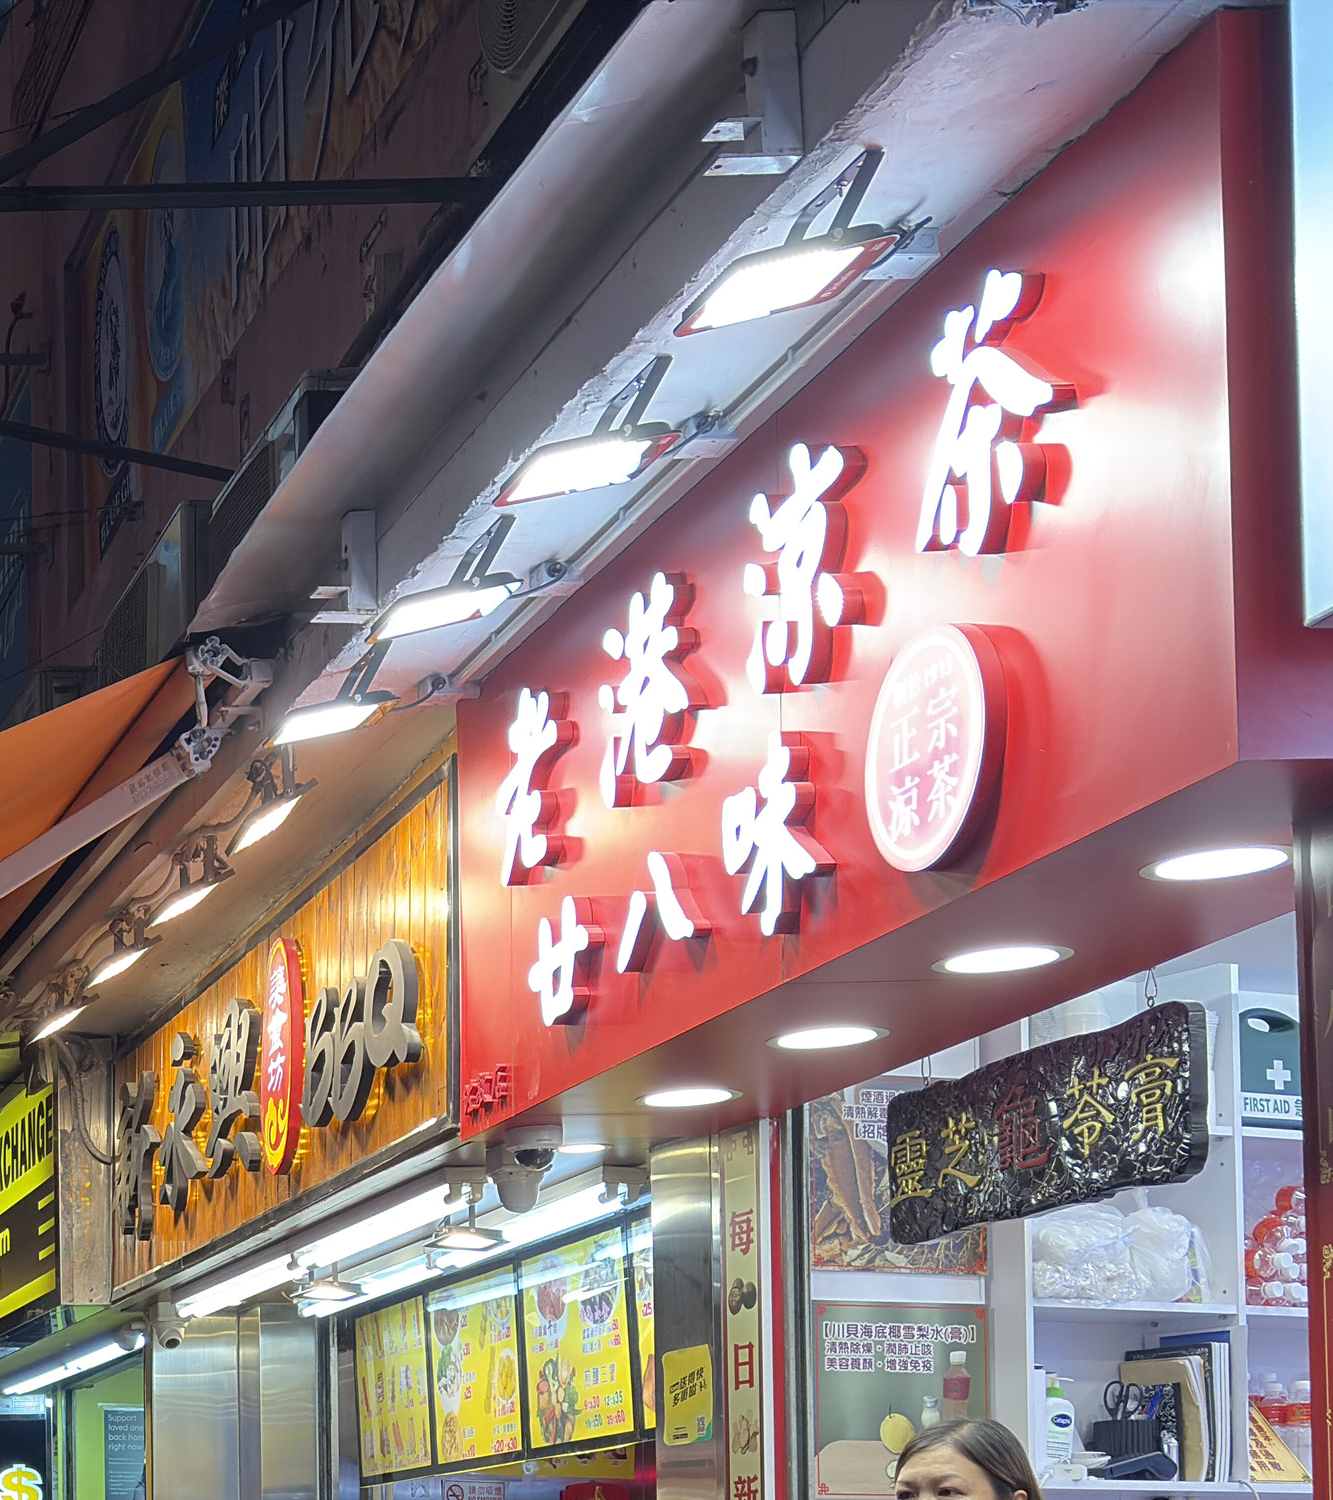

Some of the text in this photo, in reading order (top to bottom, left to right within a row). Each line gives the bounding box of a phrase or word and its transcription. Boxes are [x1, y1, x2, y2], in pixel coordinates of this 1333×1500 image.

[888, 686, 959, 774] 正宗
[529, 732, 817, 1027] 廿八味
[1243, 1097, 1270, 1112] FIRST
[1273, 1098, 1290, 1114] AID
[890, 1054, 1180, 1208] 靈芝龜苓膏
[108, 1413, 136, 1424] Support
[108, 1423, 128, 1431] loved
[108, 1442, 126, 1452] right
